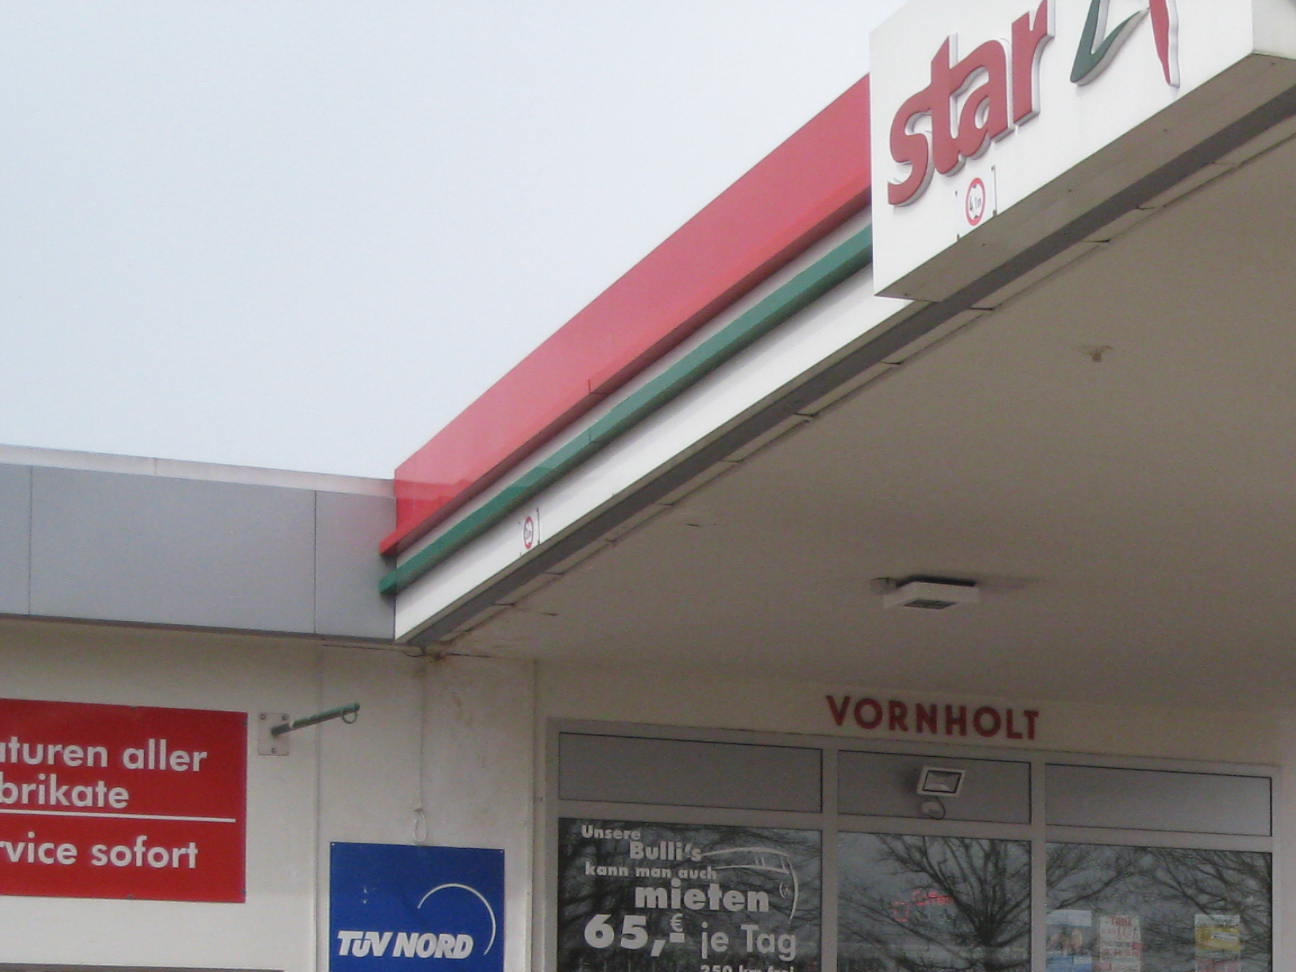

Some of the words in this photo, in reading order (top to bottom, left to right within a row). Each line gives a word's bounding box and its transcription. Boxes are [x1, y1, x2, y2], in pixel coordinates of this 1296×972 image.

[887, 0, 1053, 207] star
[826, 695, 1039, 740] VORNHOLT
[123, 738, 207, 772] aller
[0, 772, 129, 809] brikate
[581, 825, 641, 840] Unsere
[91, 834, 198, 869] sofort
[630, 840, 702, 861] Bulli's
[585, 861, 629, 877] kann
[636, 867, 672, 879] man
[678, 866, 718, 880] auch
[635, 878, 769, 912] mieten
[337, 931, 393, 957] TÜV
[392, 932, 474, 959] NORD
[701, 921, 729, 959] je
[741, 923, 796, 961] Tag
